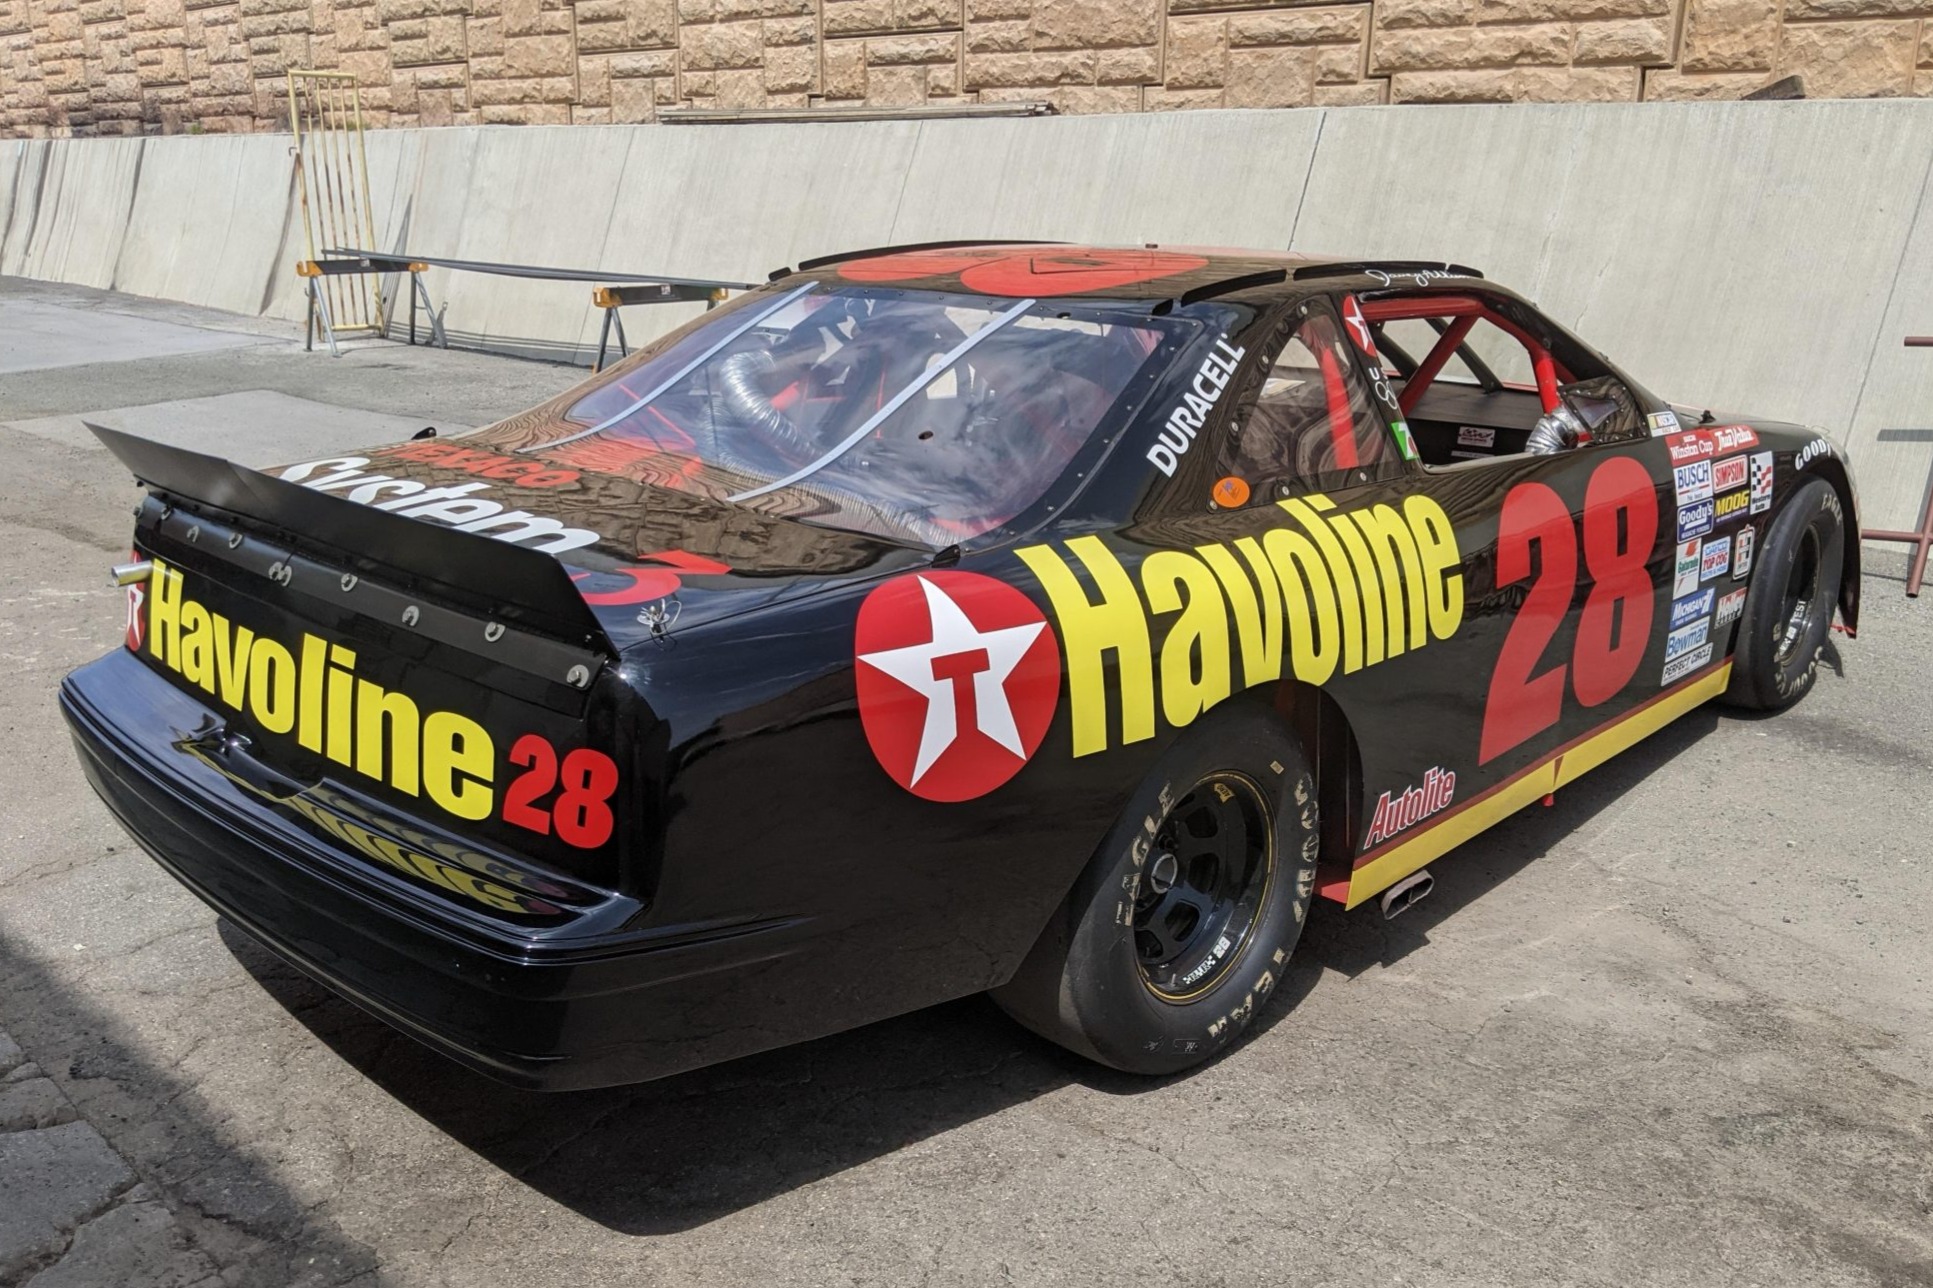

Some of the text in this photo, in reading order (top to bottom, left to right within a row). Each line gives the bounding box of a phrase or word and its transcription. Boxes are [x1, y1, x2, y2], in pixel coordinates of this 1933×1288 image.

[1146, 337, 1246, 478] DURACELL
[376, 443, 582, 487] TEXACO
[1699, 439, 1714, 456] Cup
[1678, 462, 1709, 489] BUSCH
[1715, 461, 1744, 487] SIMPSON
[1680, 502, 1713, 525] Goody's
[1714, 490, 1750, 517] MOOG
[1014, 493, 1464, 758] Havoline
[1479, 456, 1658, 766] 28
[1667, 625, 1707, 657] Bowman
[1664, 656, 1691, 677] PERFECT
[1691, 646, 1712, 664] CIRCLE
[149, 557, 495, 821] Havoline
[503, 733, 619, 849] 28
[1363, 766, 1456, 850] Autolite
